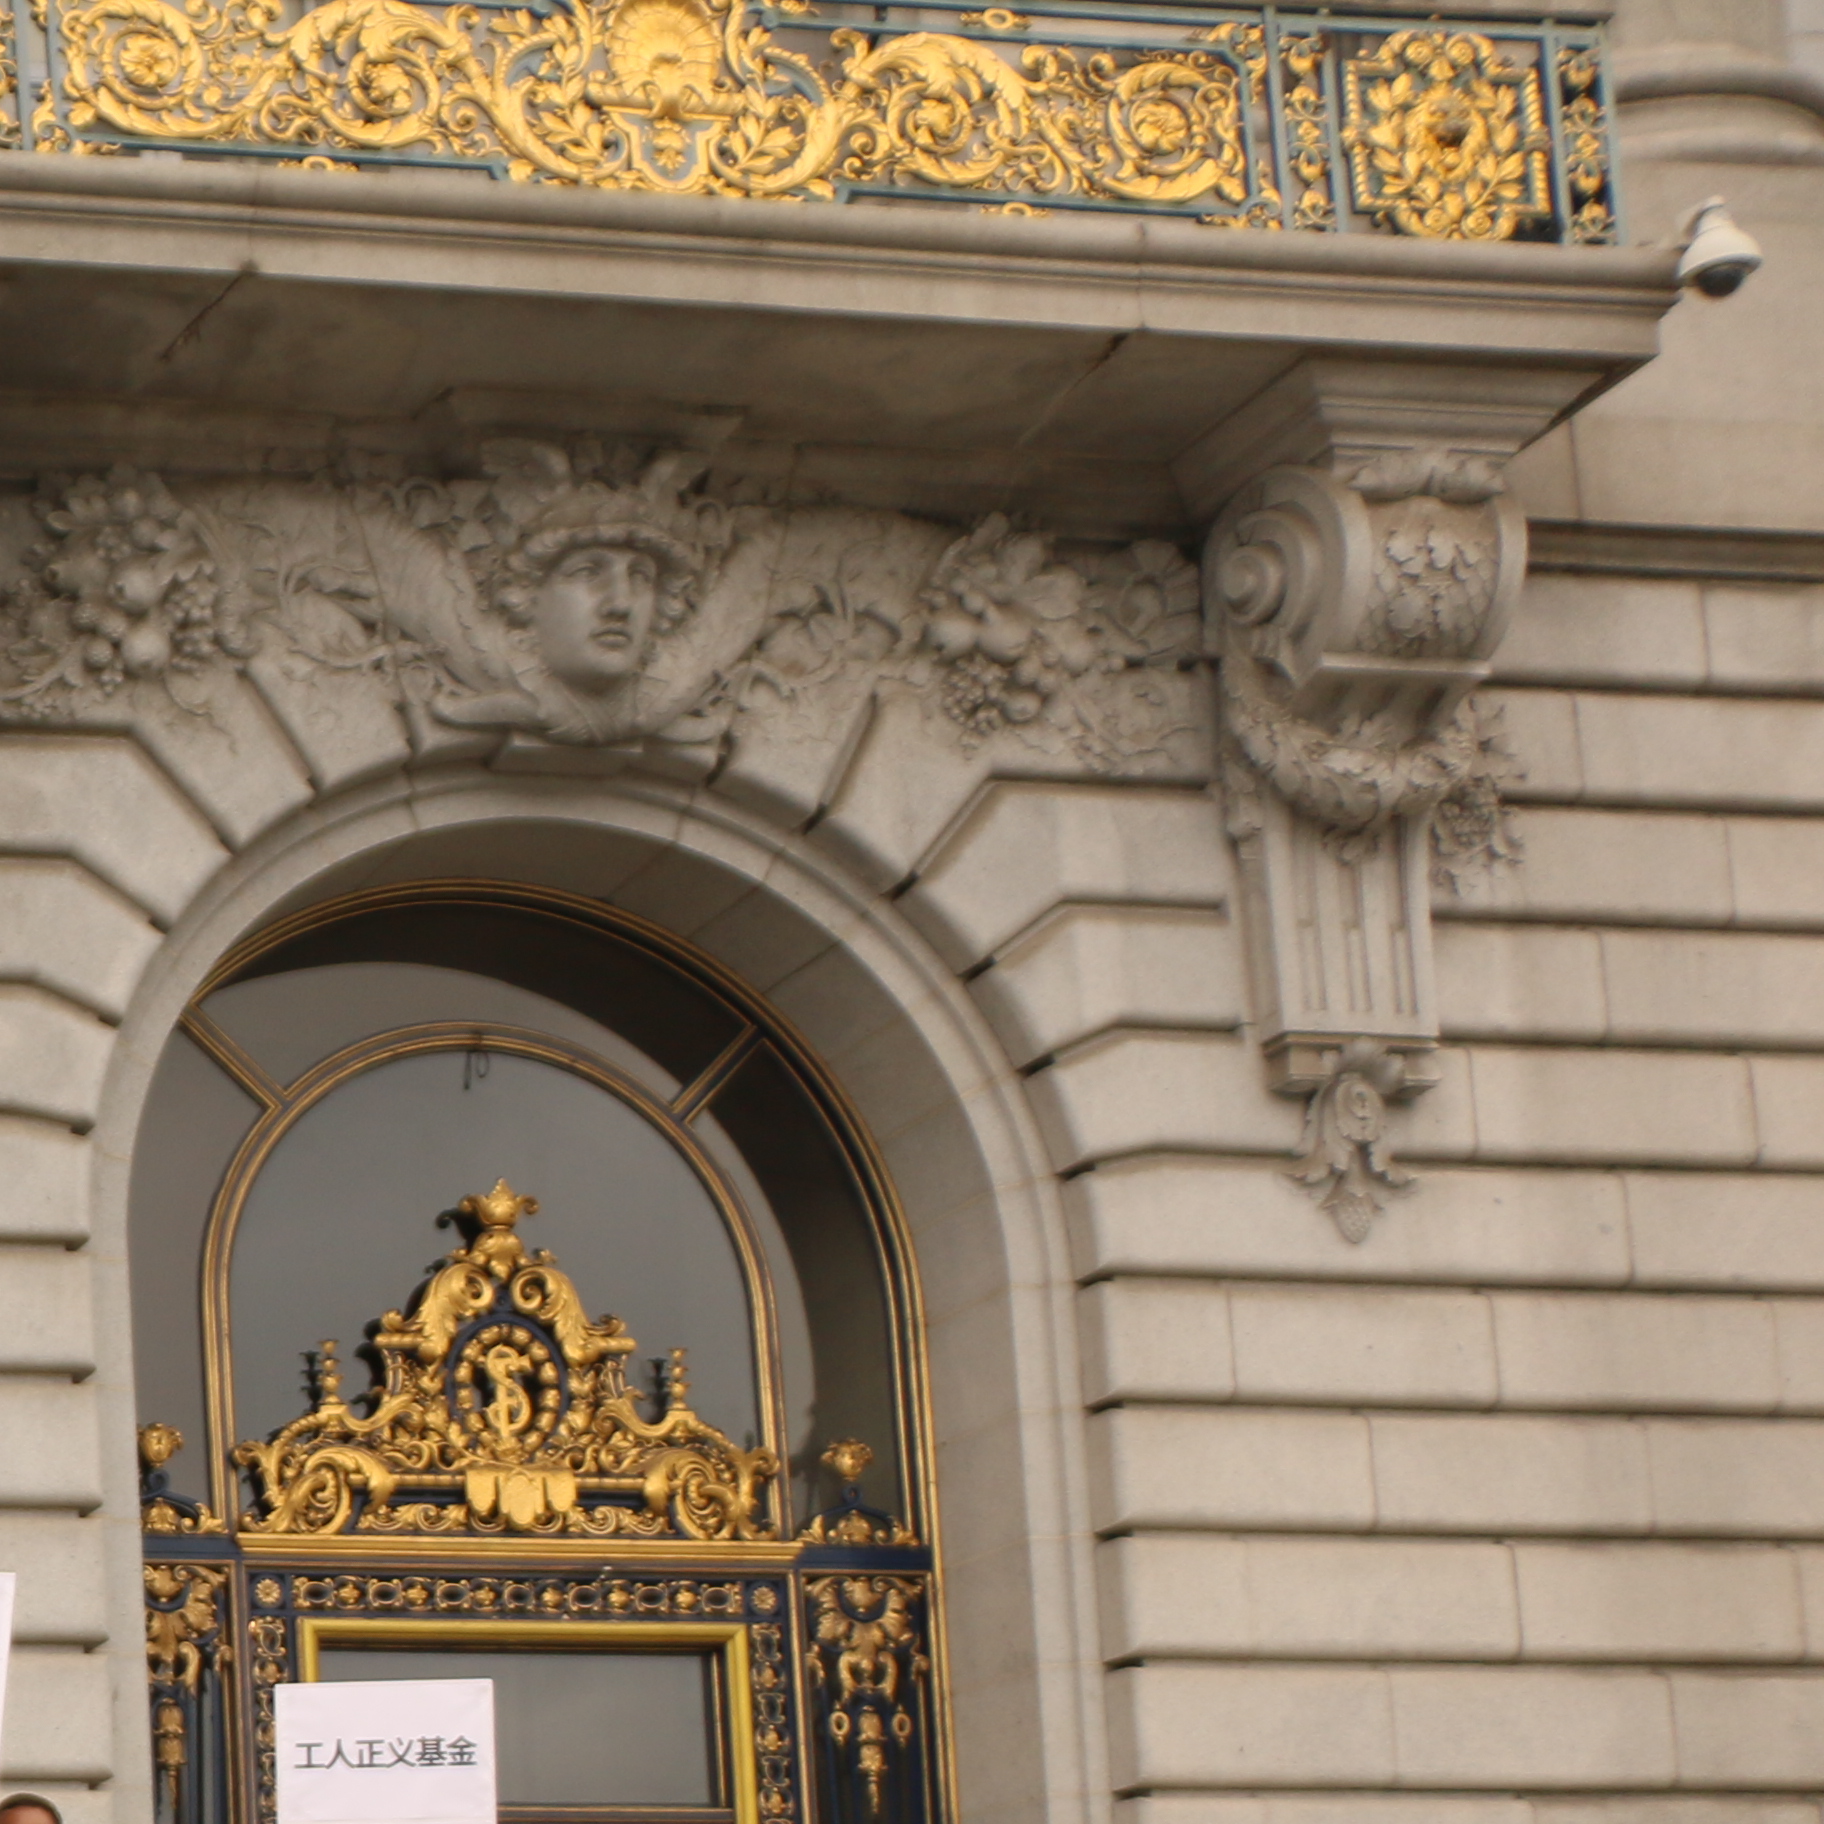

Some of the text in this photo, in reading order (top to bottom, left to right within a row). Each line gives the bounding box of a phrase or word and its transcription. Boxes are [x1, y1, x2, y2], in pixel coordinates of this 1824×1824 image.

[293, 1735, 478, 1770] 工人正义基金
